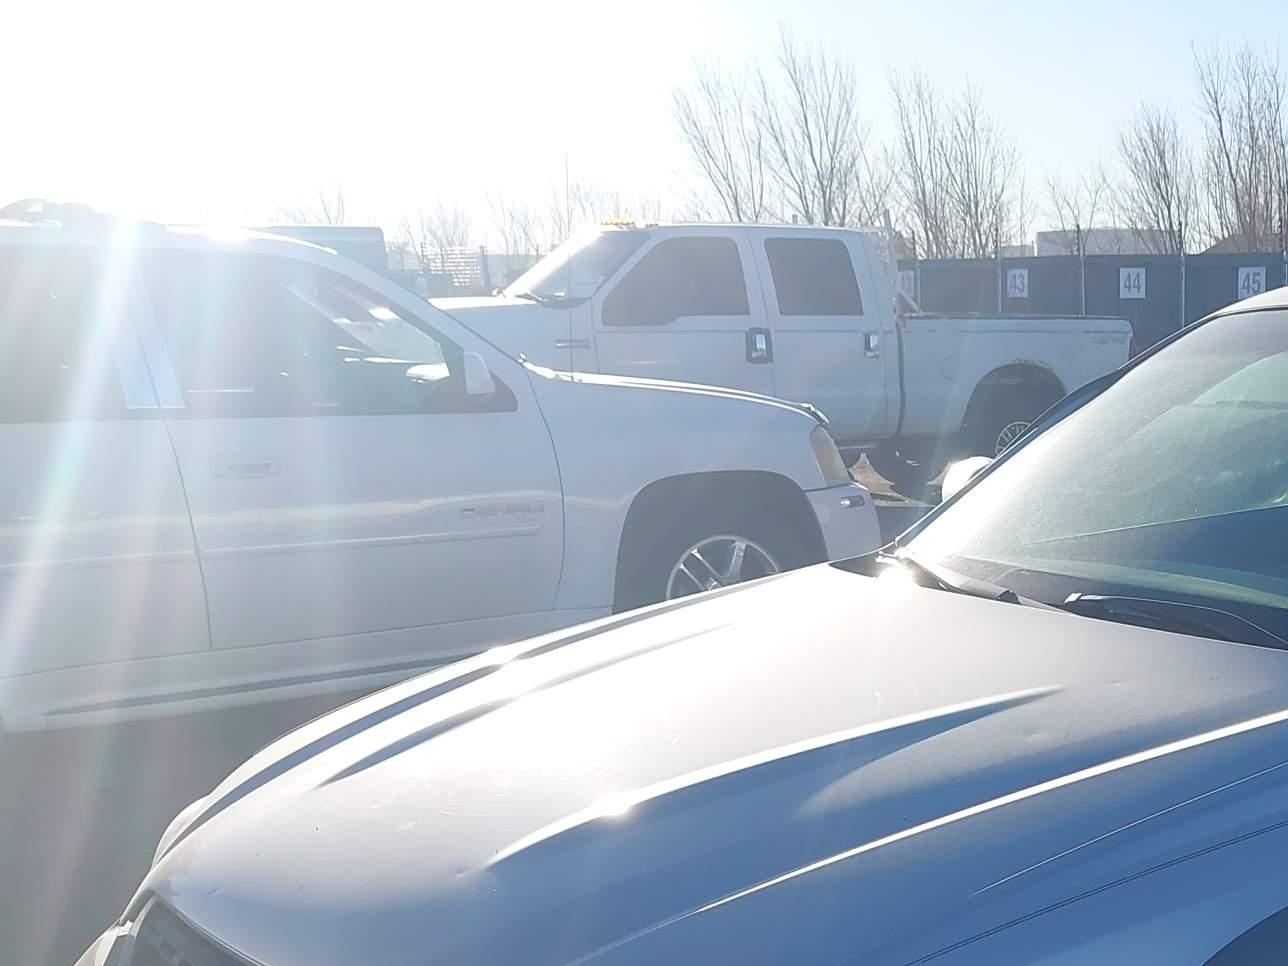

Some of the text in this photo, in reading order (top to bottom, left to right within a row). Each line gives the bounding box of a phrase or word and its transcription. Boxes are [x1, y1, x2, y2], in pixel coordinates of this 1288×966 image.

[1009, 273, 1025, 293] 43
[1123, 272, 1142, 294] 44
[1241, 271, 1261, 294] 45
